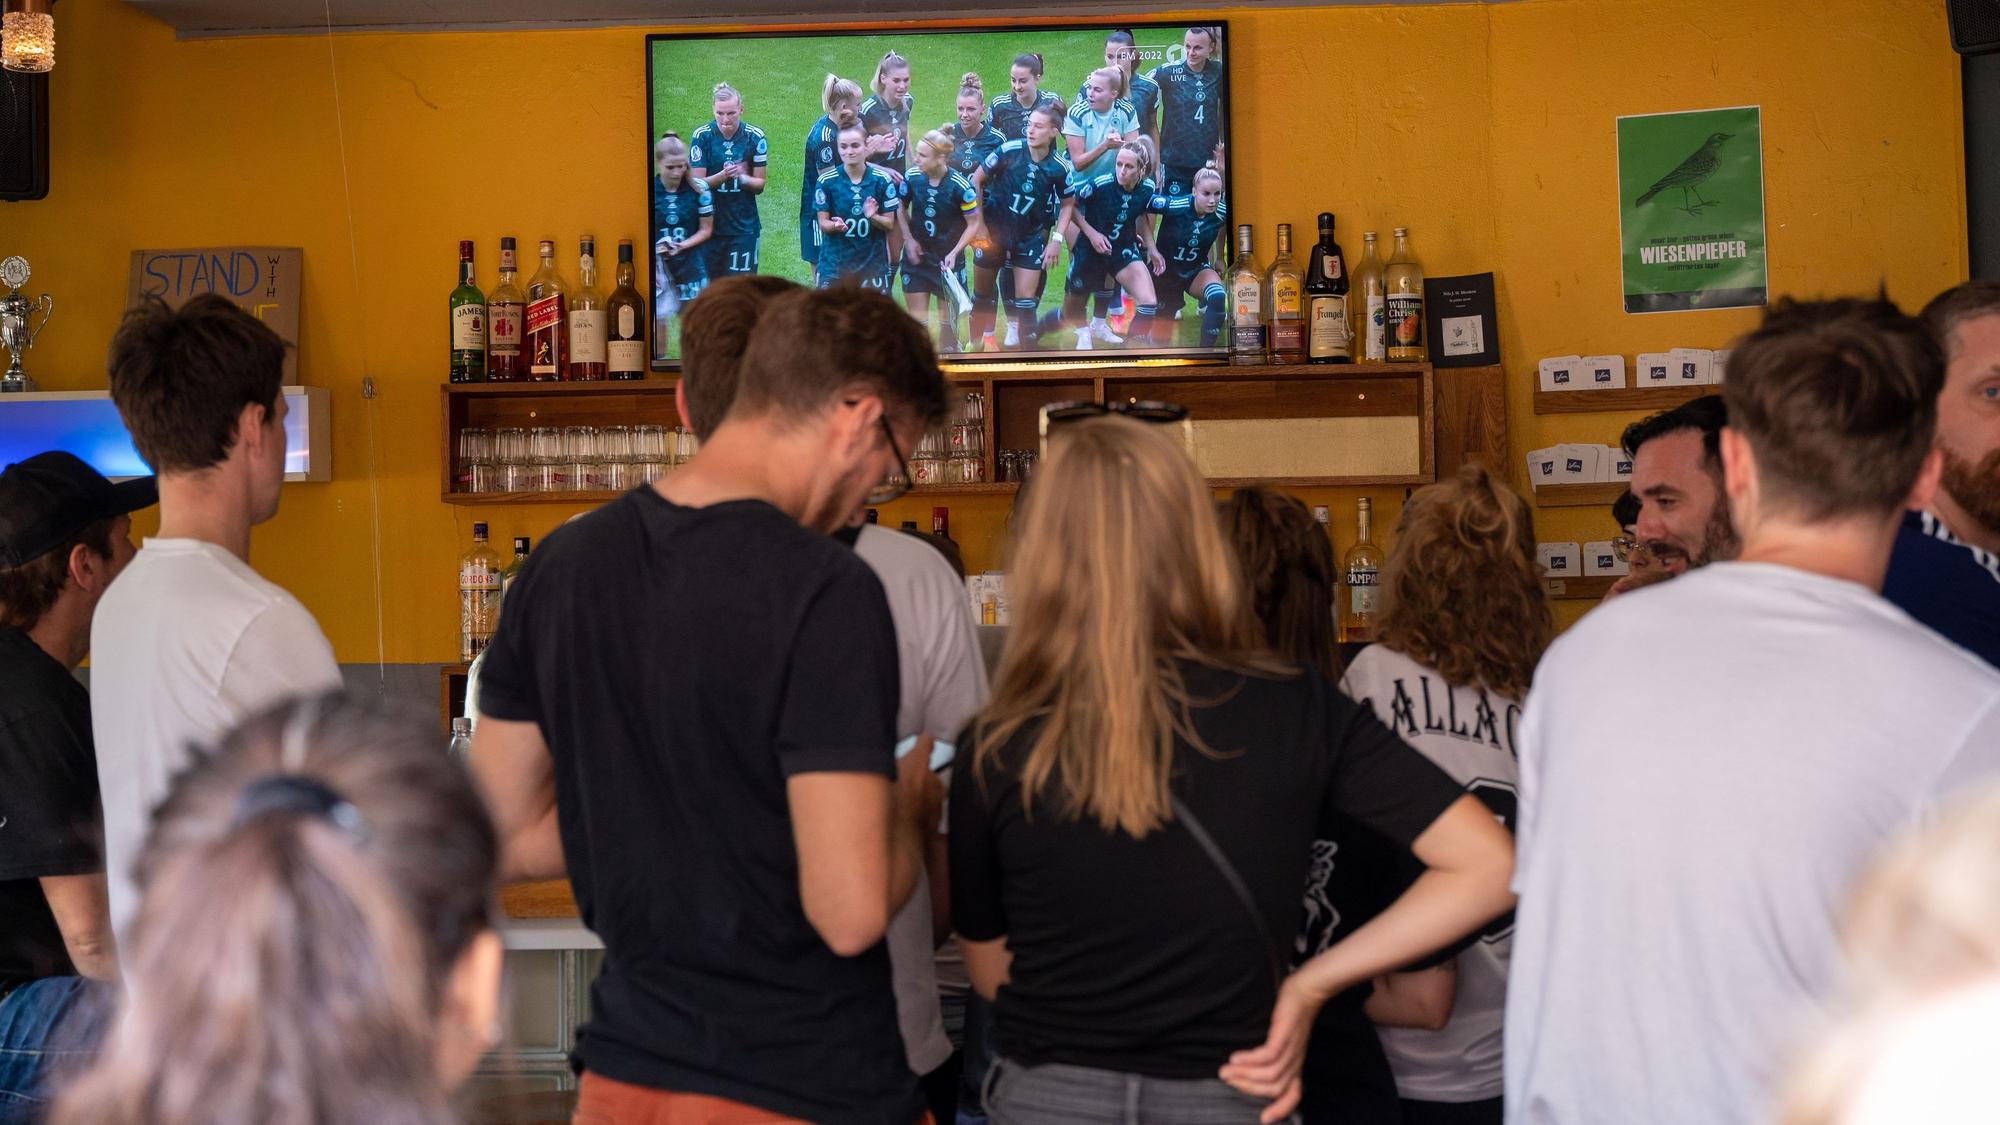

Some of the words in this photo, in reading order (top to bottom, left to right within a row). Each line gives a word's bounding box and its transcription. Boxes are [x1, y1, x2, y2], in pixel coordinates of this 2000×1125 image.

[1121, 52, 1136, 60] EM
[1139, 51, 1162, 60] 2022
[1194, 104, 1205, 124] 4
[1008, 193, 1036, 216] 17
[844, 218, 869, 238] 20
[924, 220, 936, 237] 9
[1108, 223, 1123, 240] 3
[729, 251, 751, 272] 11
[1173, 247, 1199, 262] 15
[1640, 240, 1747, 264] WIESENPIEPER
[146, 251, 259, 297] STAND
[266, 255, 281, 297] WITH
[527, 312, 539, 321] RED
[538, 304, 559, 315] LABEL
[1347, 573, 1380, 584] CAMPA
[1390, 675, 1521, 763] ALLAC
